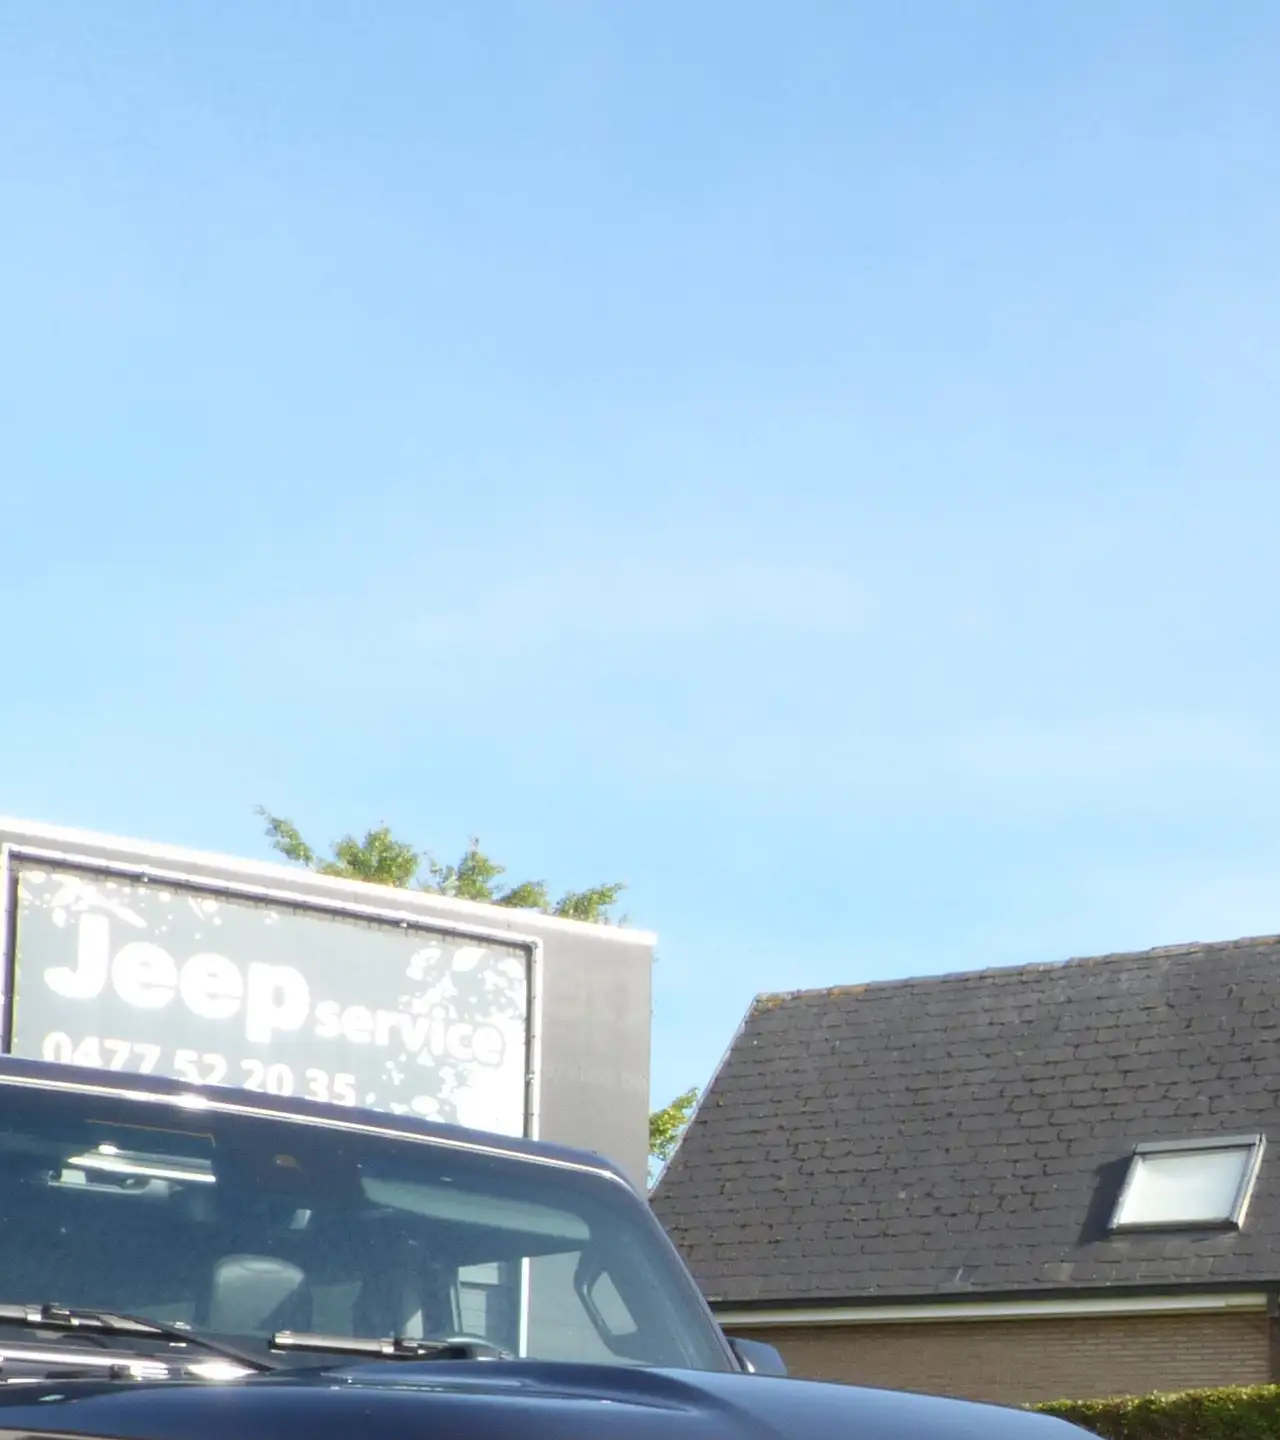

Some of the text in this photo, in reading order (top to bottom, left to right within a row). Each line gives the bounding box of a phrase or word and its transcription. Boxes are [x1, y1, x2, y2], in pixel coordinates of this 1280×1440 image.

[43, 913, 507, 1067] Jeep service
[41, 1031, 357, 1108] 0477 52 20 35
